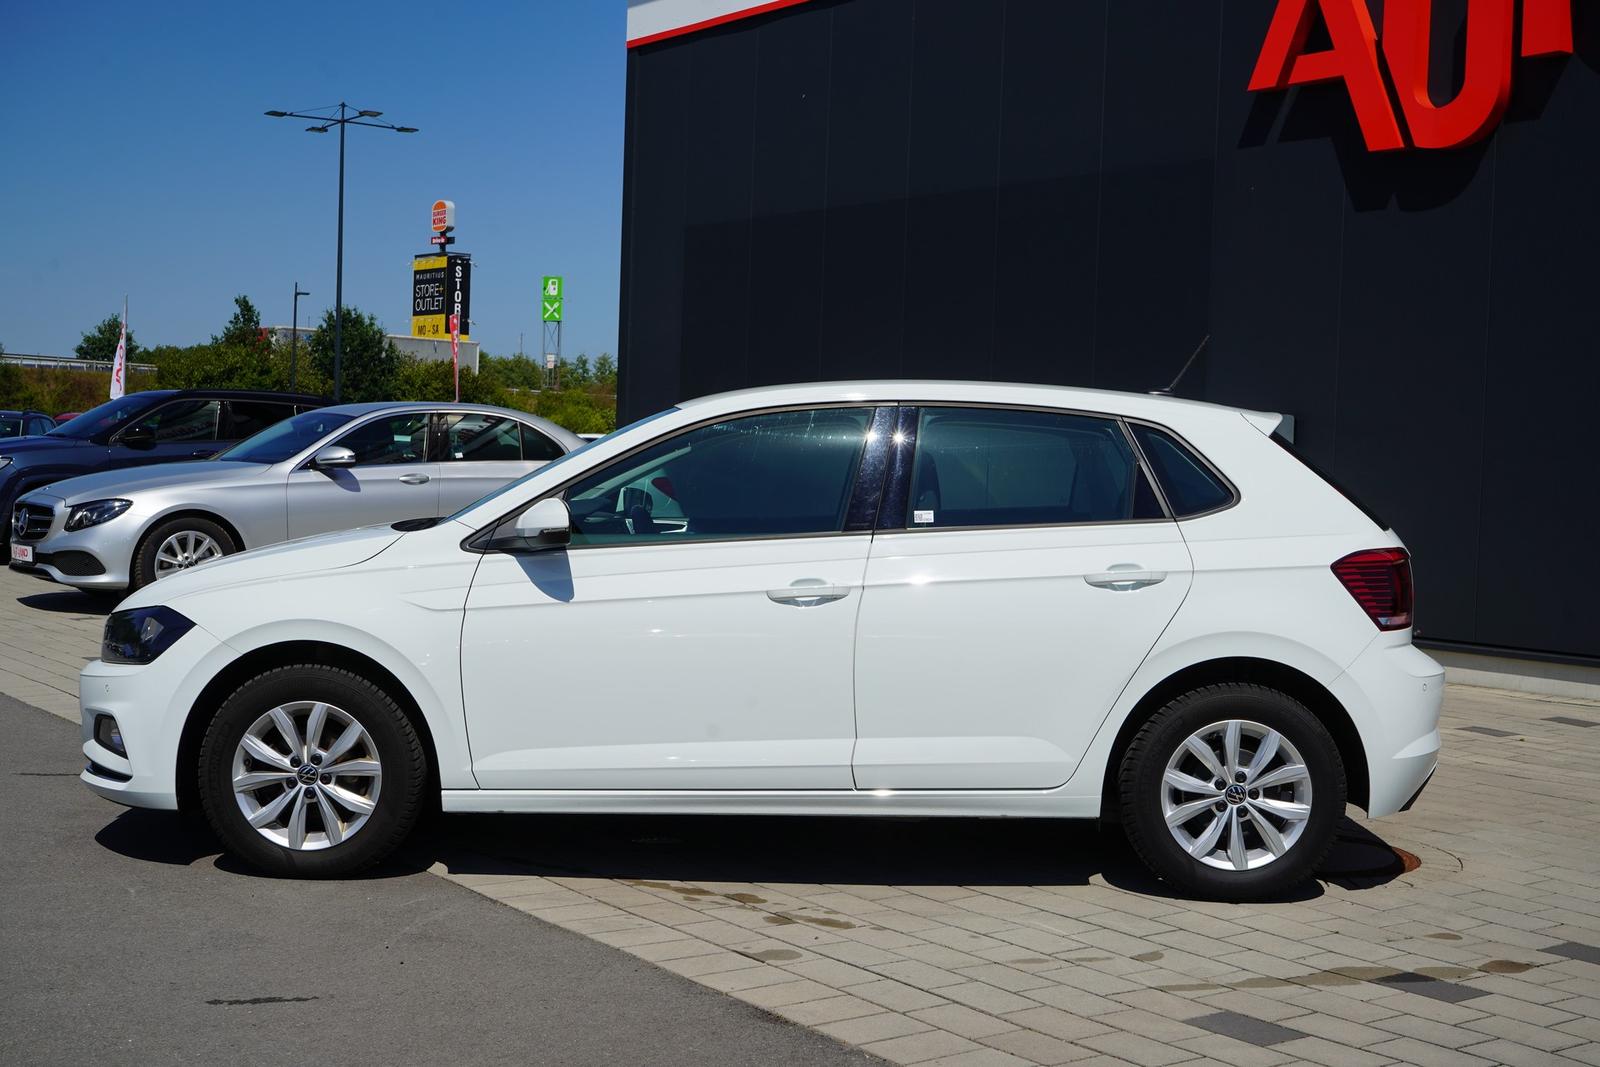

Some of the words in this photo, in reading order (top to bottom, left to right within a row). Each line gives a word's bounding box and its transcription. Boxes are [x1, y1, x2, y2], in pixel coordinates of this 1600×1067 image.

[432, 217, 447, 226] KING
[415, 272, 445, 281] MAURITIUS
[454, 266, 462, 315] STOR
[415, 297, 443, 312] OUTLET
[418, 325, 426, 336] MO
[432, 324, 439, 335] SA
